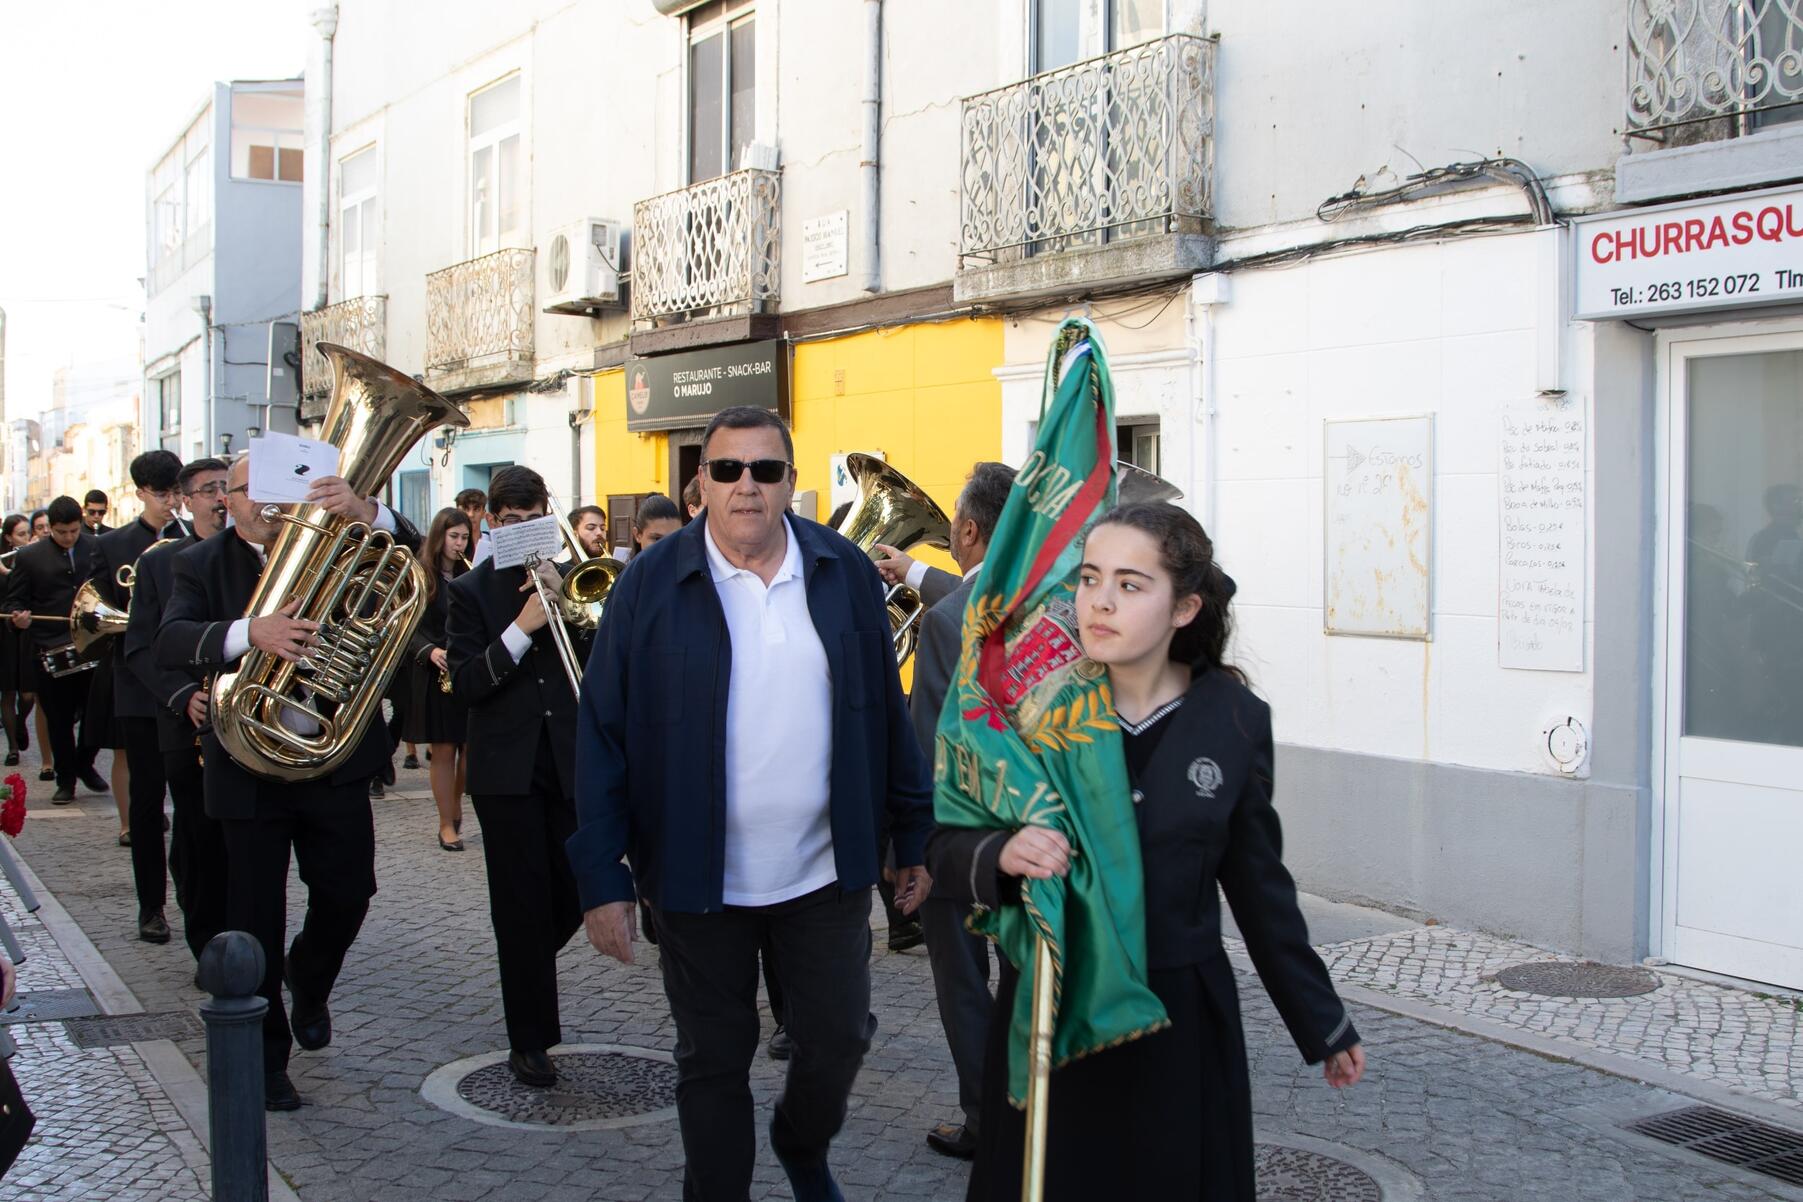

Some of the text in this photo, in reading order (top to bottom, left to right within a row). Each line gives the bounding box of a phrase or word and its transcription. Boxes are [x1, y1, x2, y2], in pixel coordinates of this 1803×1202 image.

[1592, 204, 1803, 264] CHURRASQU
[1611, 287, 1643, 306] Tel.:
[1648, 282, 1682, 302] 263
[1687, 278, 1719, 298] 152
[1724, 273, 1760, 294] 072
[673, 367, 722, 383] RESTAURANTE
[728, 361, 771, 377] SNACK-BAR
[674, 383, 712, 398] O MARUJO
